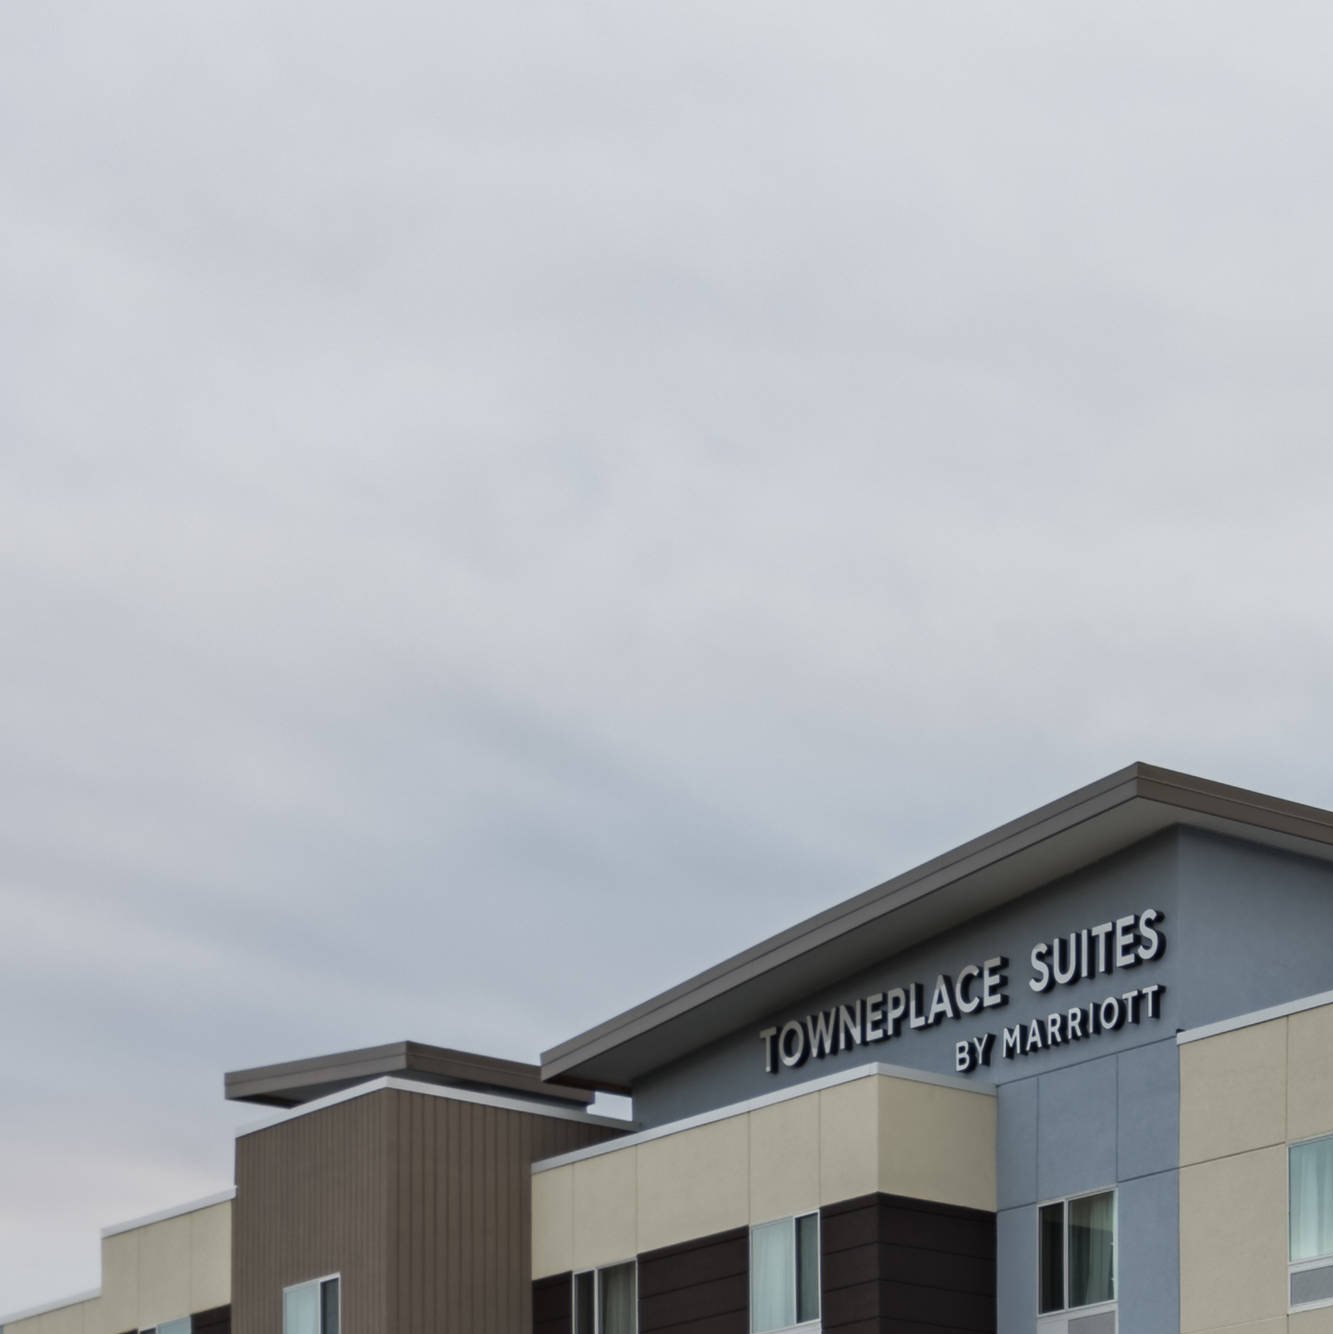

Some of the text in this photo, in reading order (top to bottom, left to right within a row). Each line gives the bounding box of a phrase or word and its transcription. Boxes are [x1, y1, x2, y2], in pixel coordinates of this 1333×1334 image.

[759, 908, 1164, 1073] TOWNEPLACE SUITES
[955, 983, 1165, 1073] BY MARRIOTT
